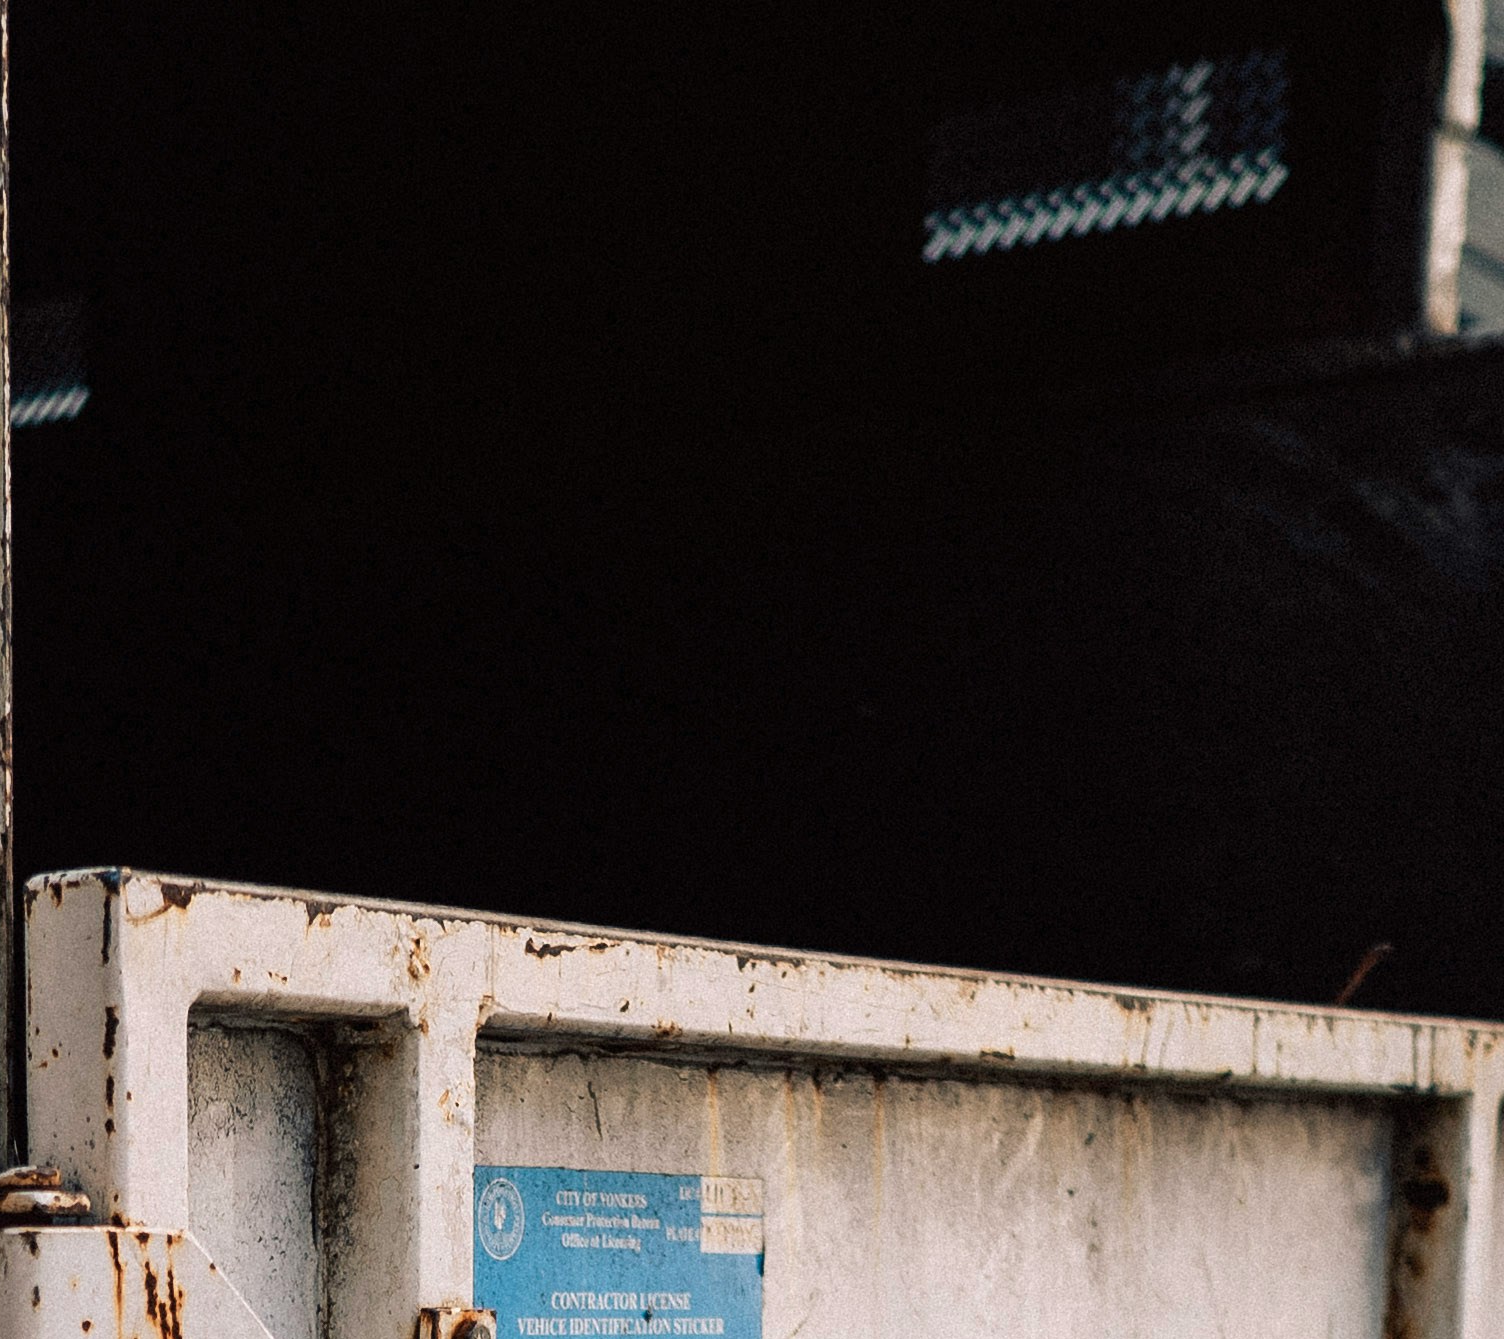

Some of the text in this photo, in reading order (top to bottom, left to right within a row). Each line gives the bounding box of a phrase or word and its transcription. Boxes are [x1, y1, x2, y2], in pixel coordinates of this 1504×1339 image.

[556, 1190, 648, 1209] CITY OF YONKERS
[541, 1211, 660, 1230] Consumer Protection Bureau
[561, 1233, 641, 1252] Office of Licensing
[551, 1291, 692, 1311] CONTRACTOR LICENSE
[517, 1317, 724, 1336] VEHICE IDENTIFICATION STICKER
